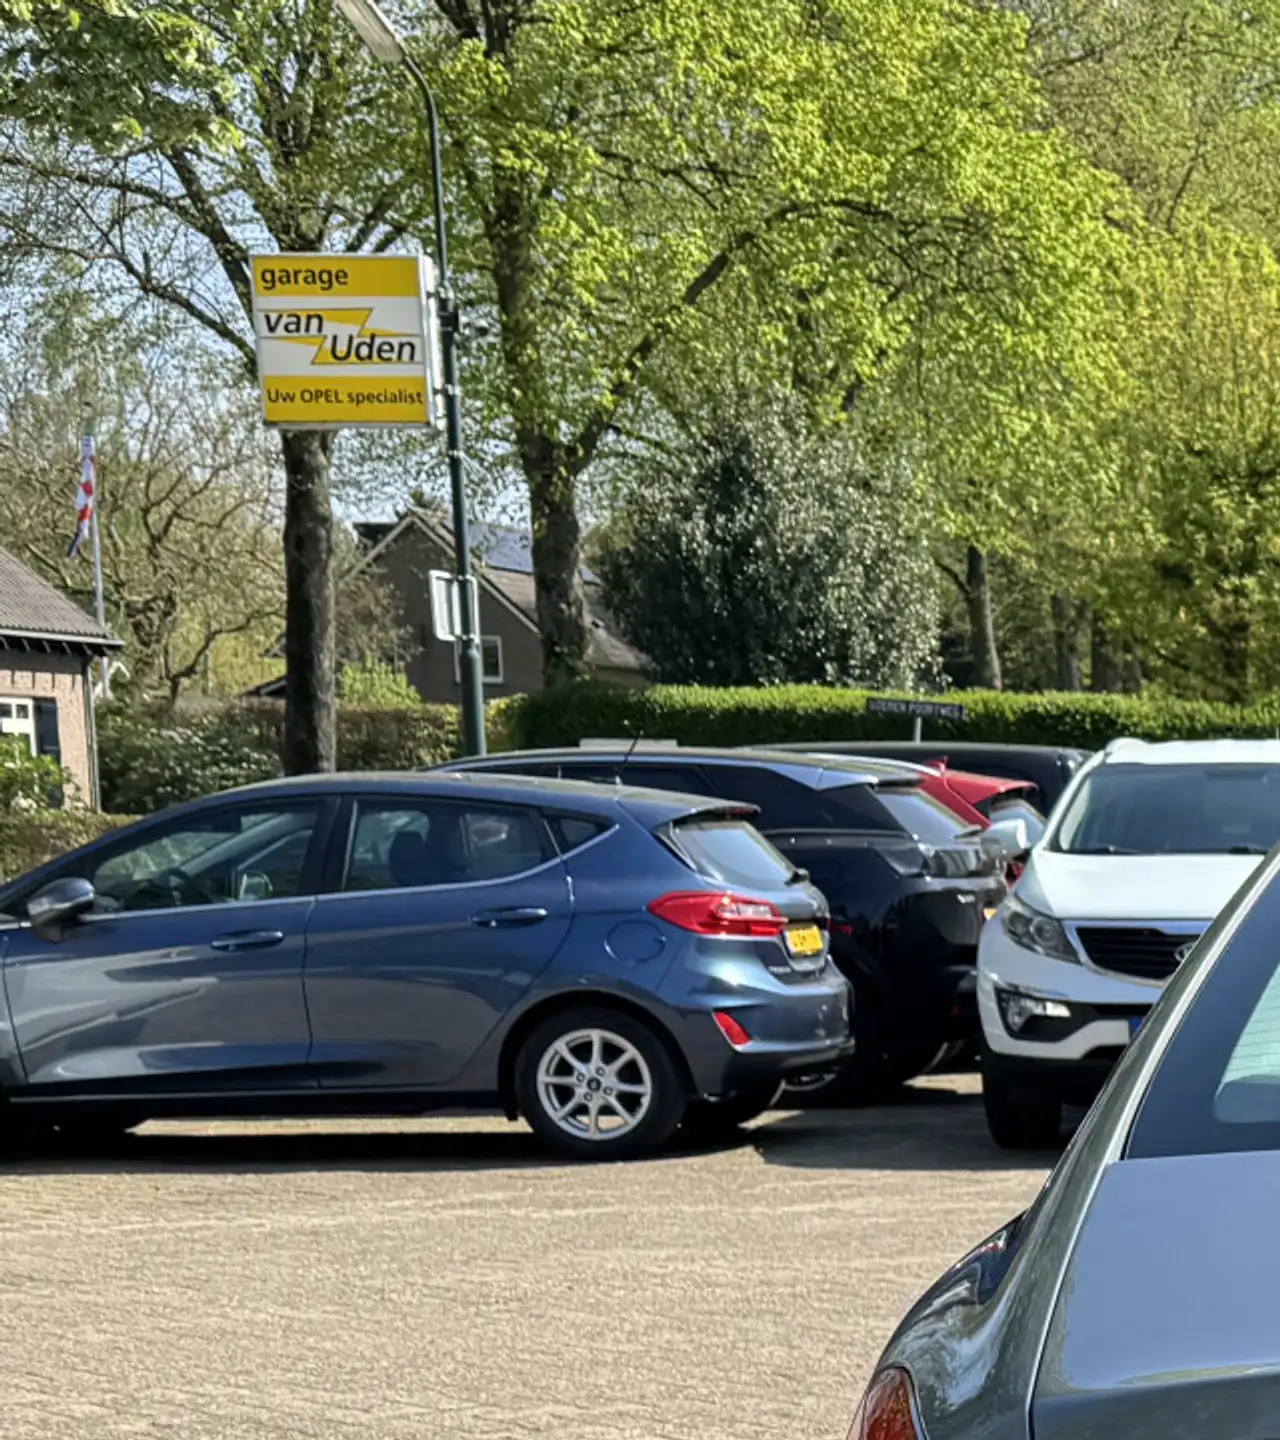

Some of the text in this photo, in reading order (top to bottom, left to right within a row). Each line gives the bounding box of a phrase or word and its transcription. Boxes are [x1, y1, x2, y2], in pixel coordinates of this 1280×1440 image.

[261, 268, 349, 290] garage
[264, 312, 324, 334] van
[330, 334, 416, 362] Uden
[267, 388, 424, 406] Uw OPEL specialist
